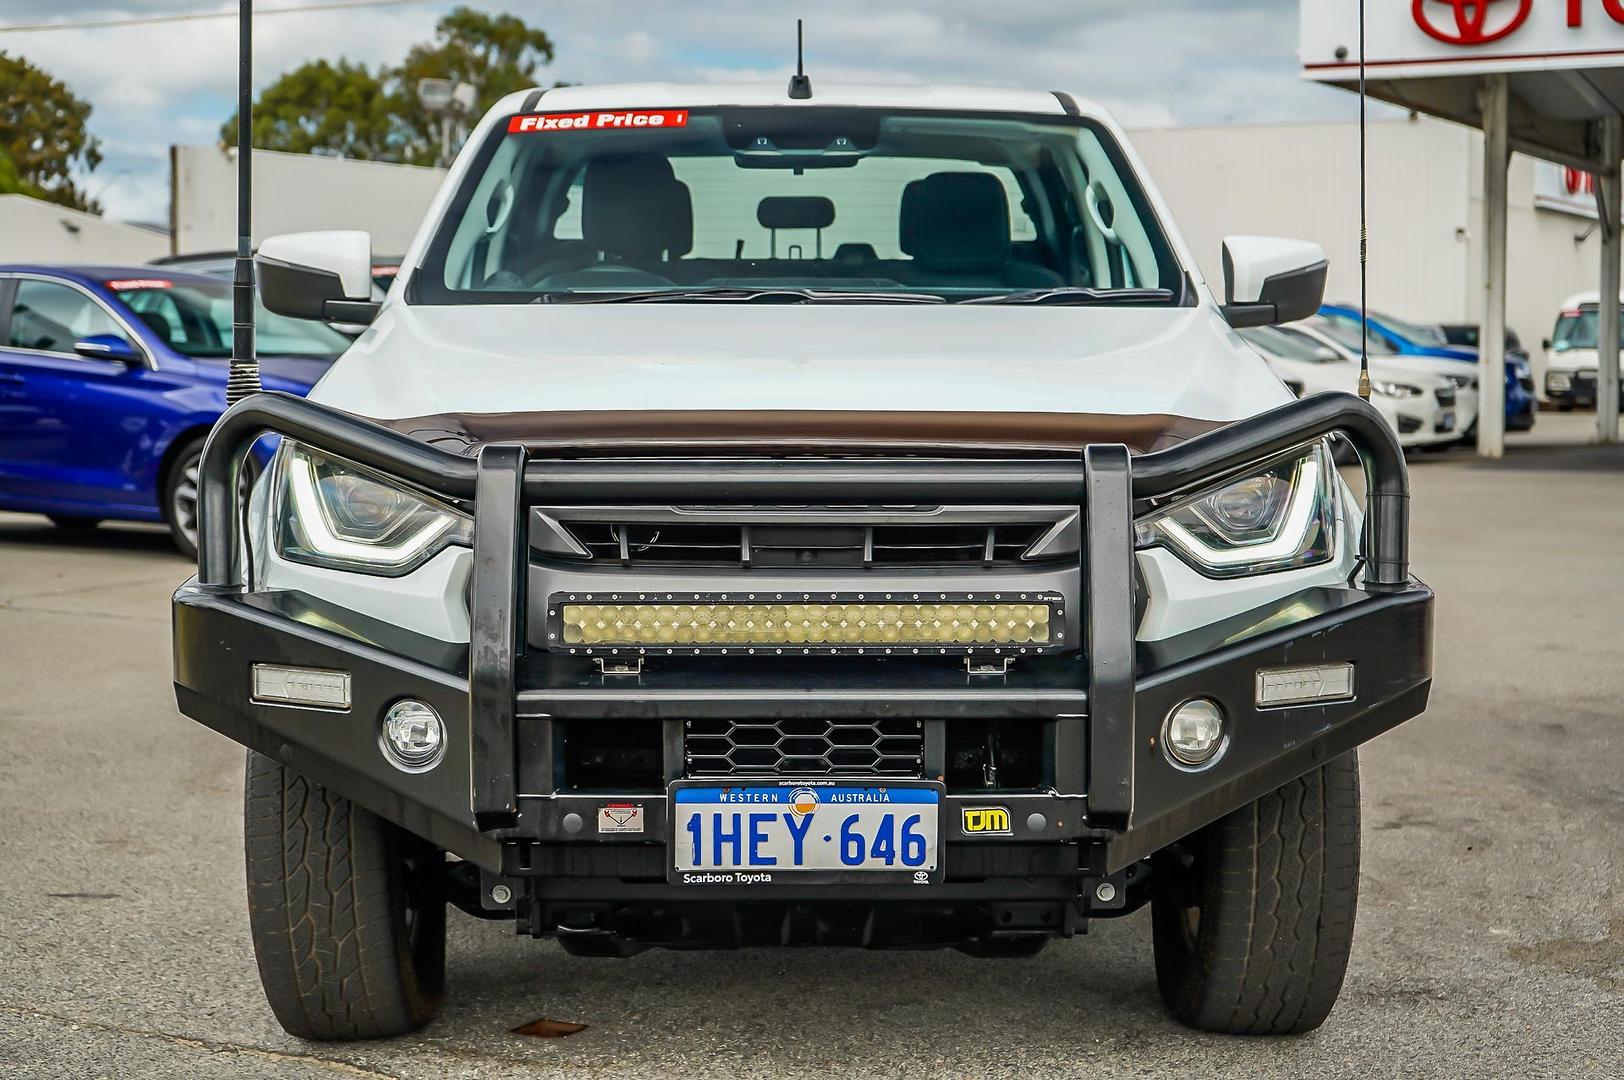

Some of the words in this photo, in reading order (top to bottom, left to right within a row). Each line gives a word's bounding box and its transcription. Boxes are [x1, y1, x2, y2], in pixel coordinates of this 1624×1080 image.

[520, 117, 590, 130] Fixed
[596, 114, 665, 126] Price
[719, 793, 778, 802] WESTERN
[831, 793, 890, 802] AUSTRALIA
[683, 873, 733, 883] Scarboro
[735, 872, 772, 884] Toyota
